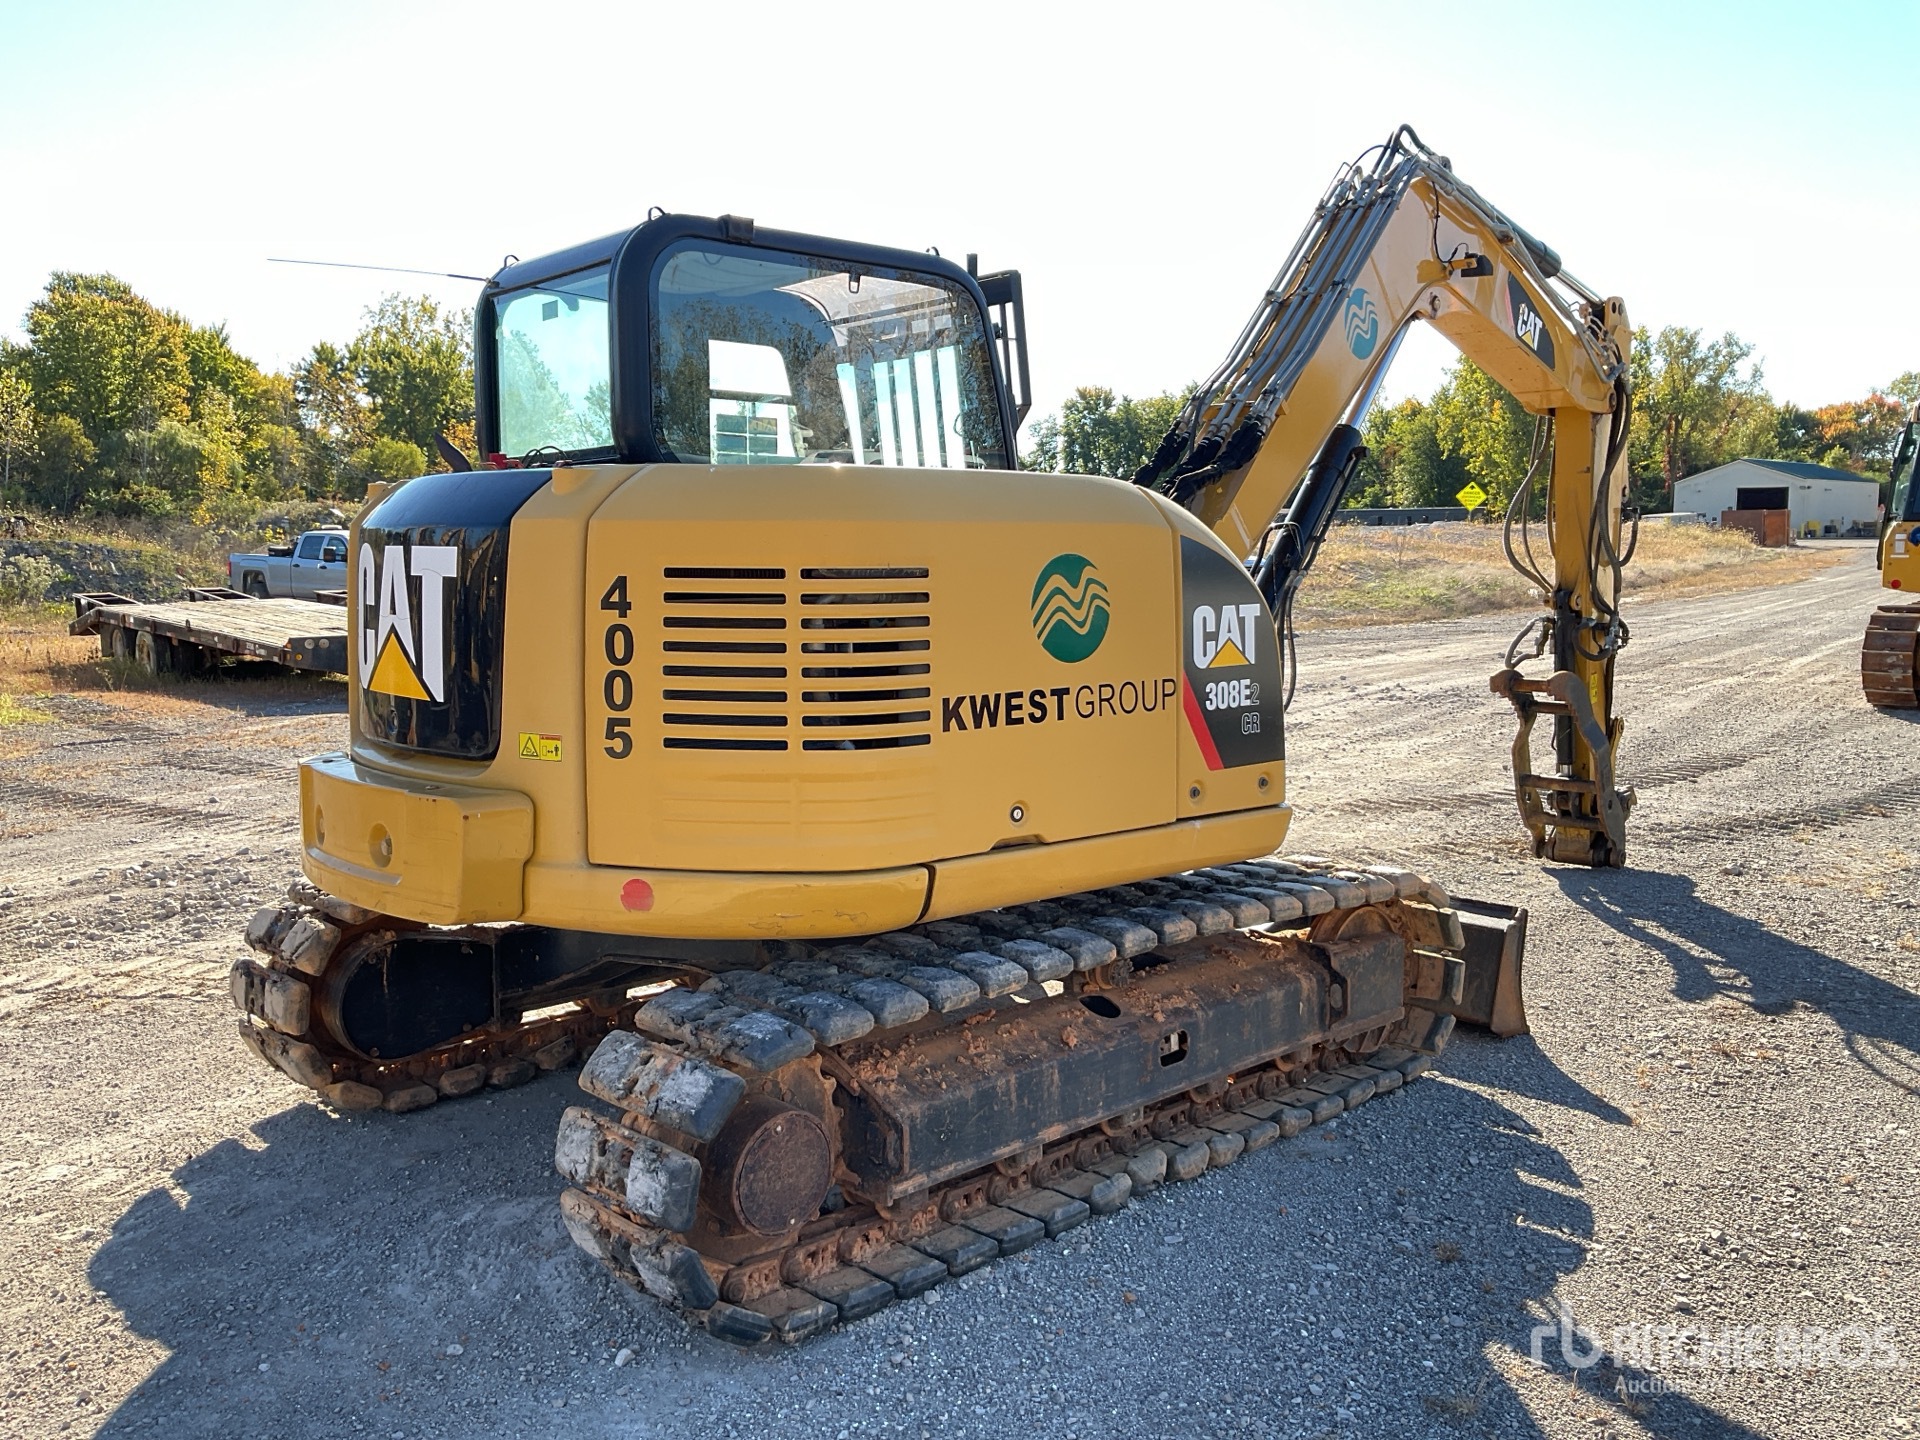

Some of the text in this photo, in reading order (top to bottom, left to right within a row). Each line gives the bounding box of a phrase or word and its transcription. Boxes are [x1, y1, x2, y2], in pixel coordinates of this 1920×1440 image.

[1517, 303, 1543, 351] CAT
[358, 542, 458, 703] CAT
[1193, 603, 1260, 669] CAT
[600, 575, 634, 760] 4005
[1205, 679, 1260, 711] 308E2
[1241, 712, 1260, 735] CR
